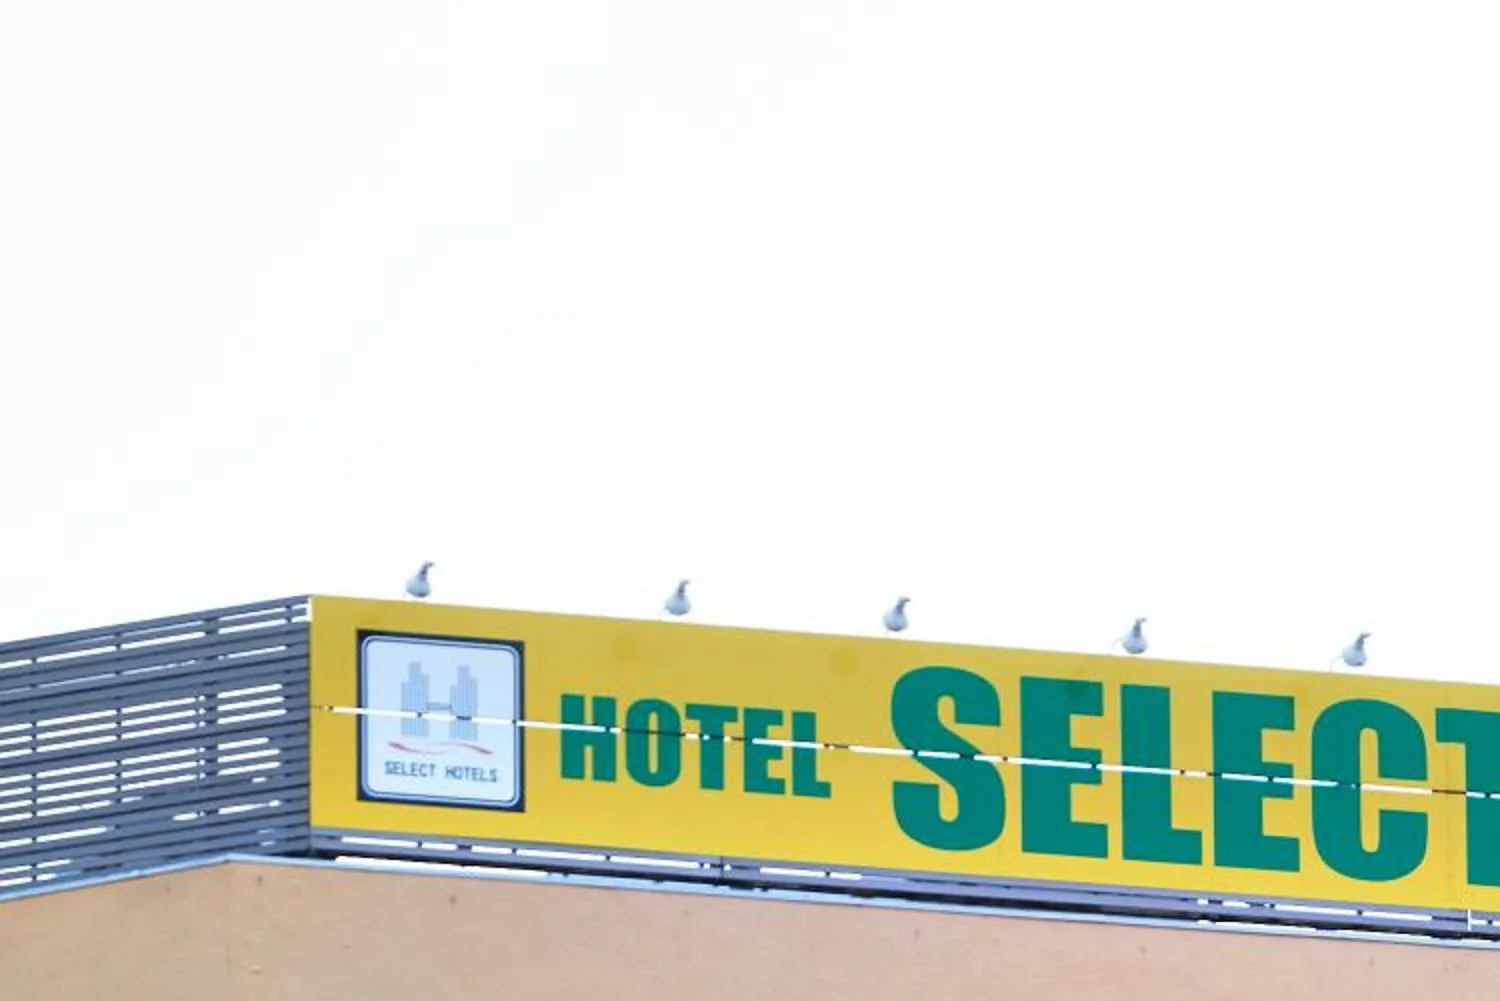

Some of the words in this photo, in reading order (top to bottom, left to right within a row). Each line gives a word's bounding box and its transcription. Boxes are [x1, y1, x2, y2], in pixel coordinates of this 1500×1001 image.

[384, 760, 436, 778] SELECT
[445, 766, 498, 783] HOTELS
[559, 694, 832, 798] HOTEL
